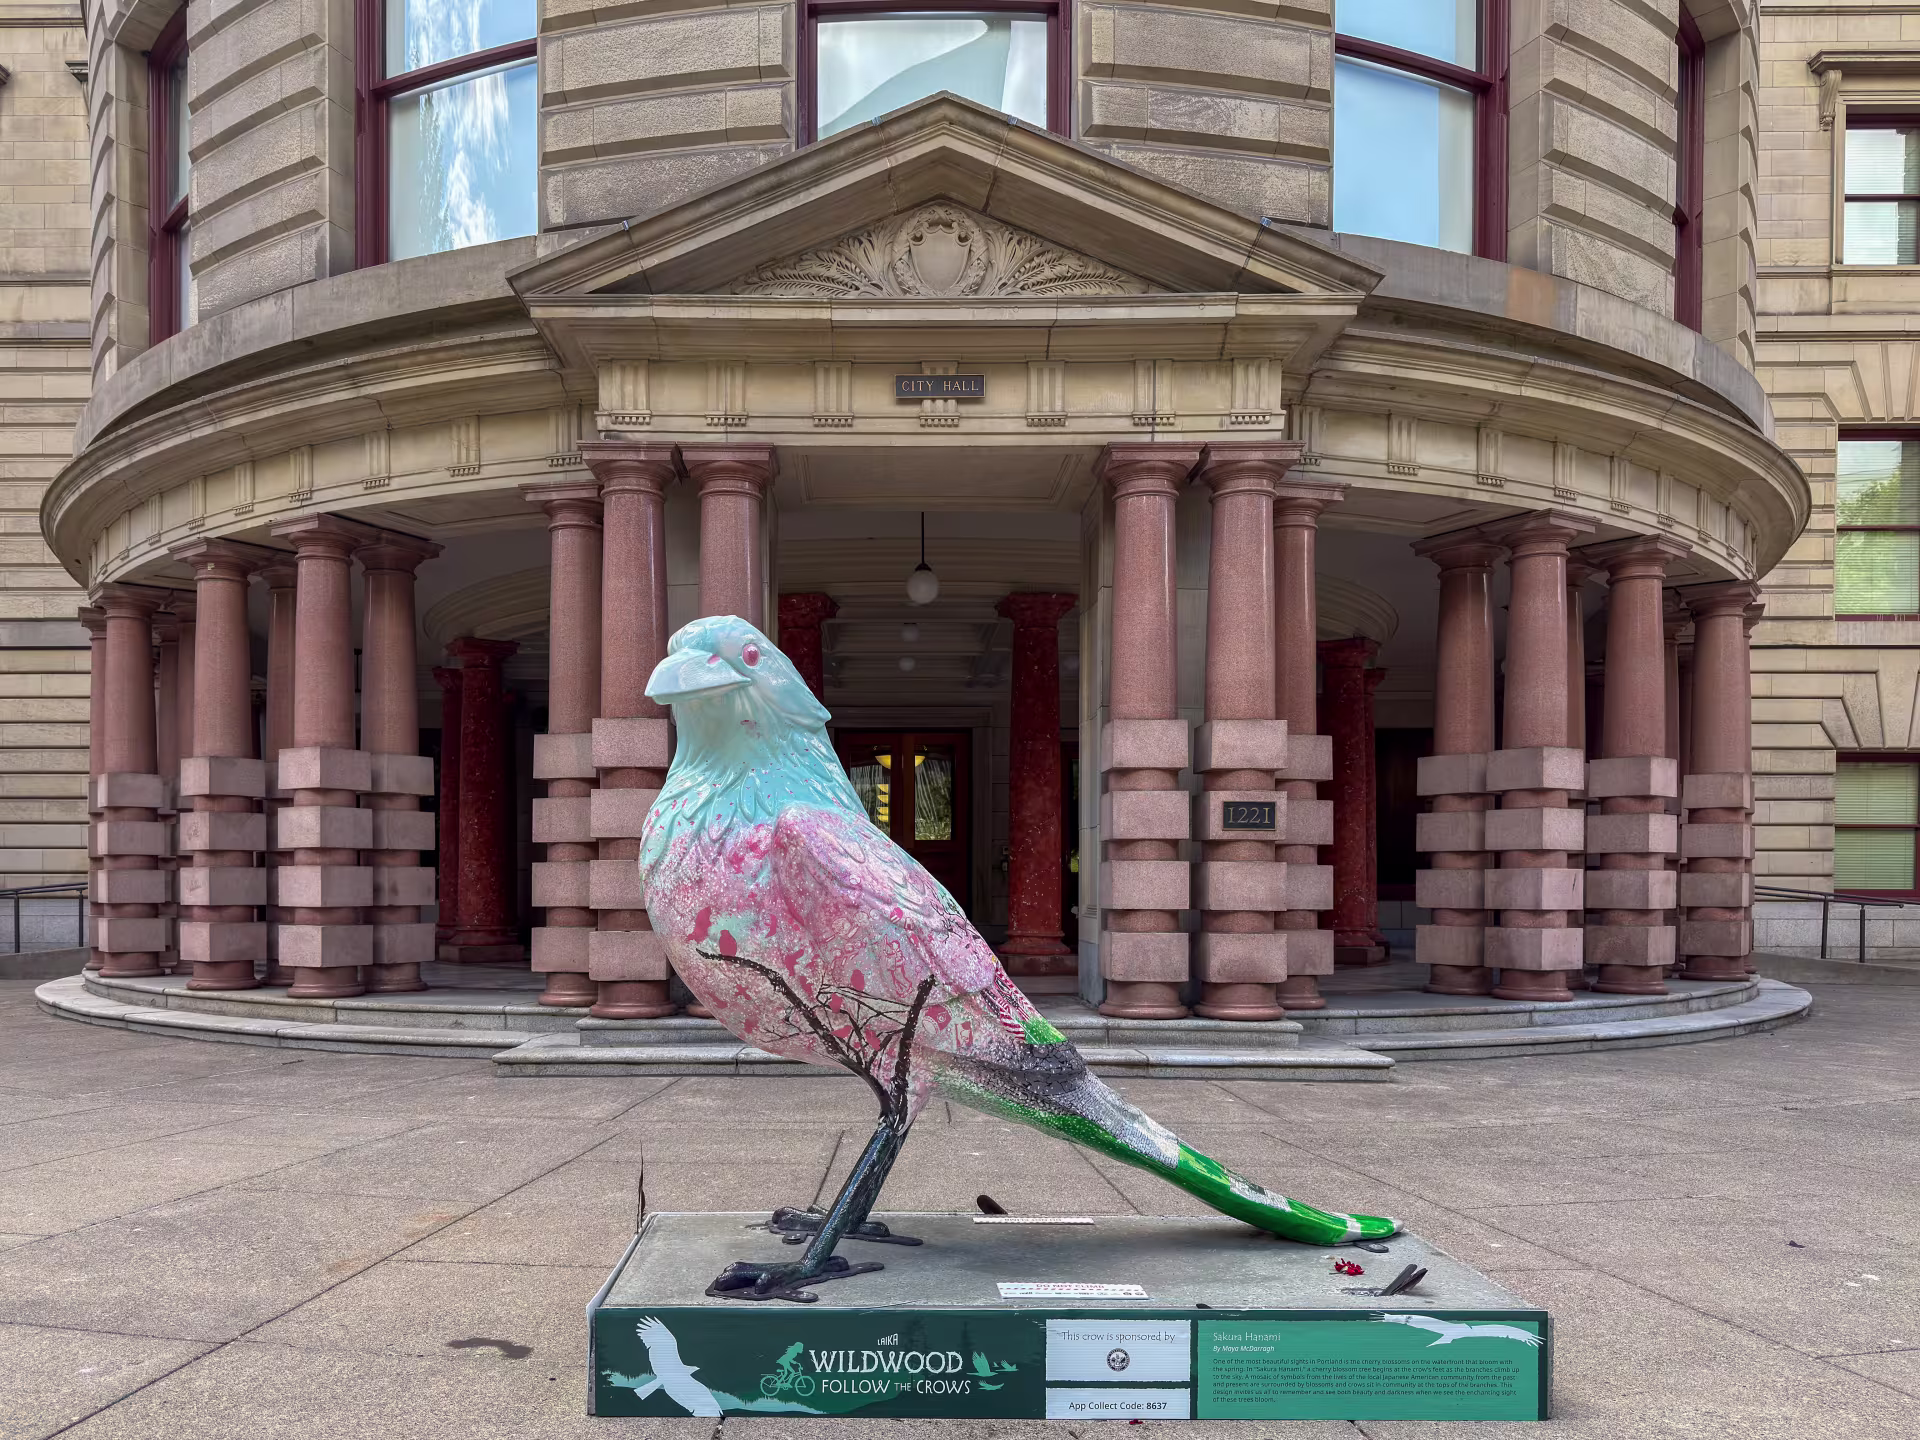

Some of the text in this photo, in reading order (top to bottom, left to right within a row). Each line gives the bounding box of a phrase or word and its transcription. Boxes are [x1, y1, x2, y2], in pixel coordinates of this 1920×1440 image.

[902, 380, 978, 392] CITY HALL
[1228, 807, 1270, 824] 1221
[878, 1334, 898, 1346] LAIKA
[1062, 1331, 1080, 1340] This
[1106, 1332, 1114, 1340] is
[1116, 1332, 1161, 1343] sponsored
[1164, 1332, 1176, 1343] by
[1213, 1332, 1280, 1341] Sakura Hanami
[809, 1350, 963, 1374] WILDWOOD
[822, 1380, 972, 1394] FOLLOW THE CROWS
[1069, 1402, 1086, 1411] App
